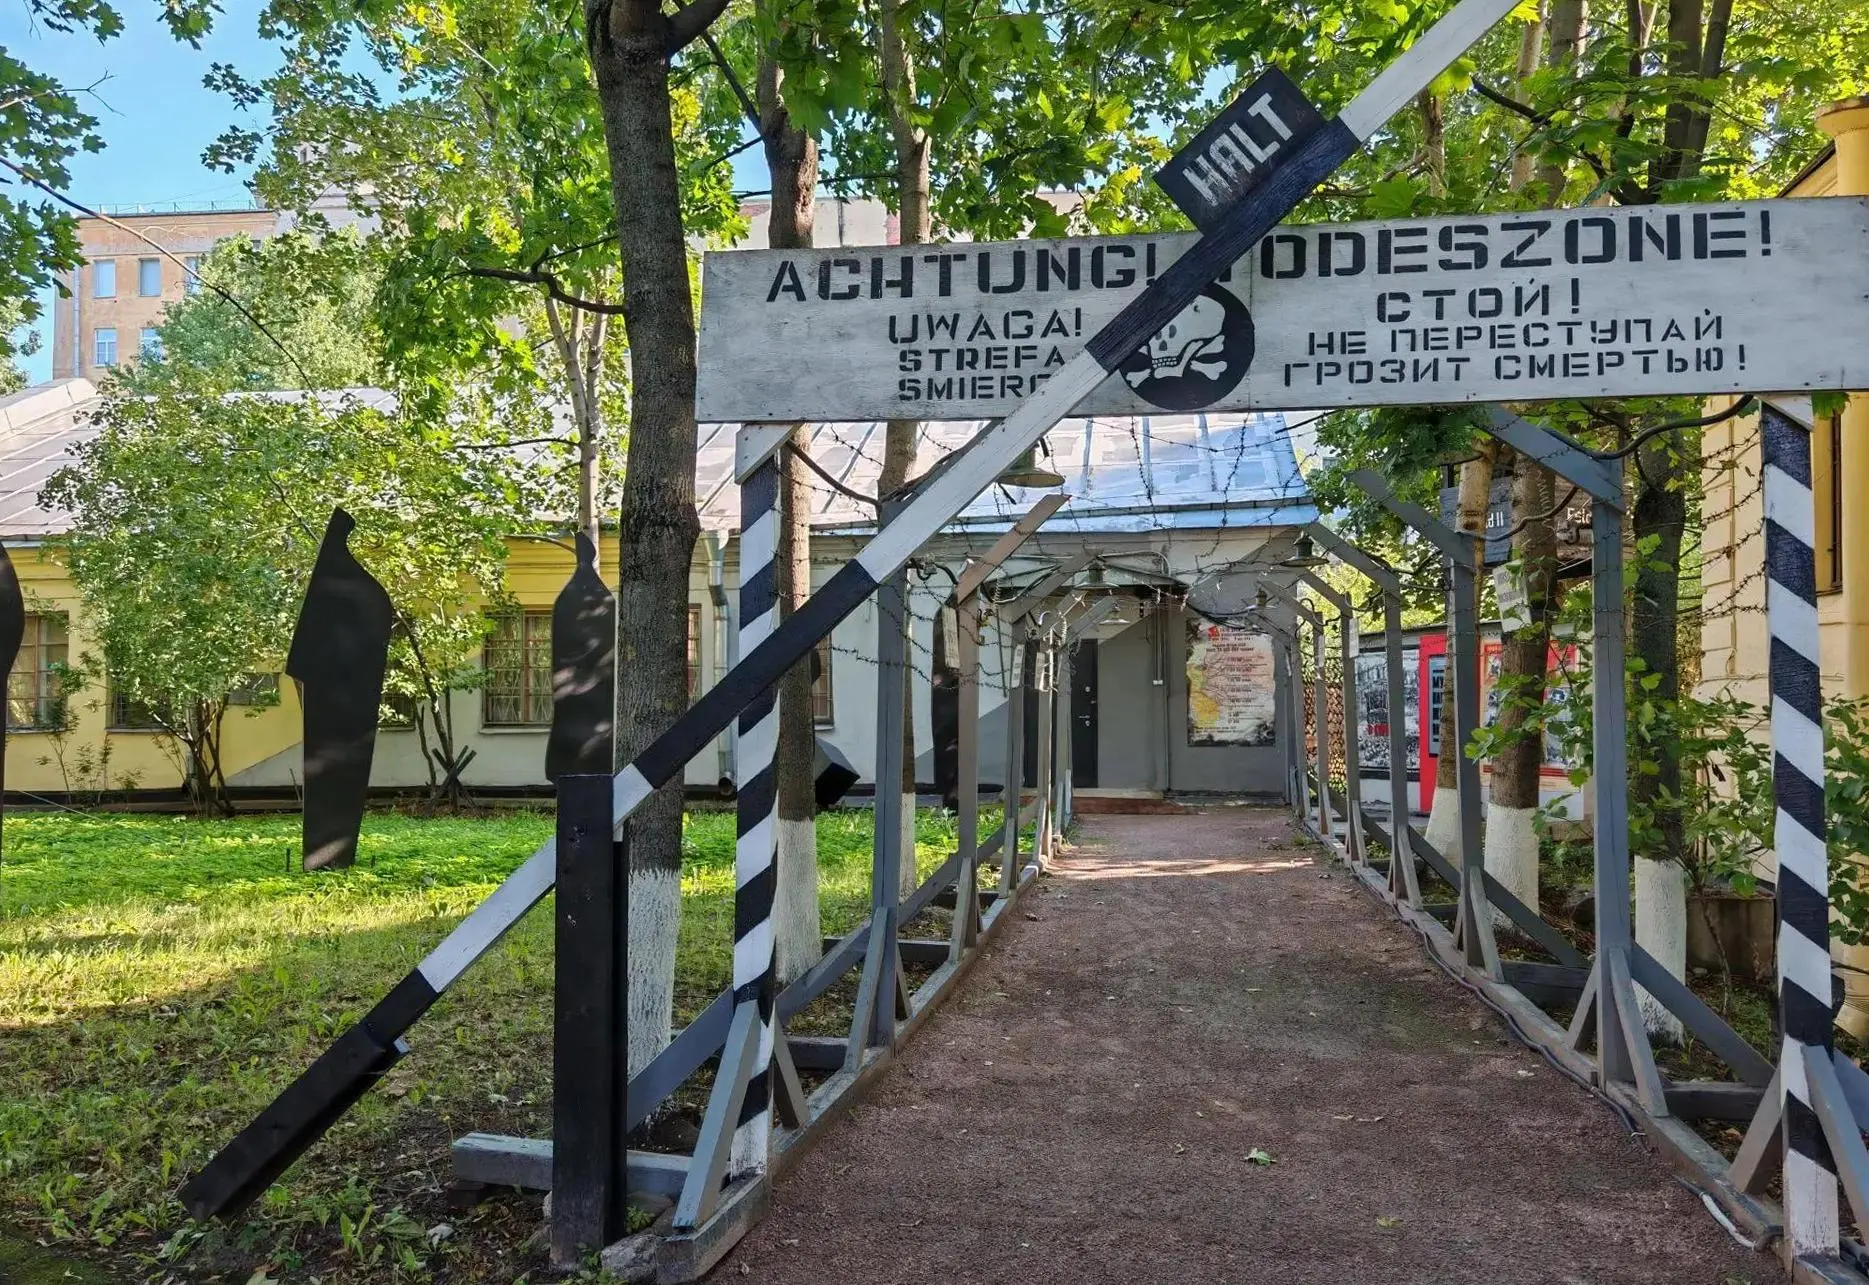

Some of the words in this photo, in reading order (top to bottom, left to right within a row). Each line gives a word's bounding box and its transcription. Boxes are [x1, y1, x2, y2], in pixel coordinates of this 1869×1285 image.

[1182, 92, 1293, 207] HALT
[766, 243, 1157, 303] ACHTUNG!
[1219, 210, 1772, 282] ODESZONE!
[1376, 277, 1581, 324] СТОЙ!
[888, 307, 1083, 345] UWAGA!
[1308, 330, 1367, 356] НЕ
[1391, 309, 1723, 353] ПЕРЕСТУПАЙ
[898, 345, 1066, 373] STREFA
[1284, 356, 1471, 388] ГРОЗИТ
[1494, 344, 1747, 382] СМЕРТЬЮ!
